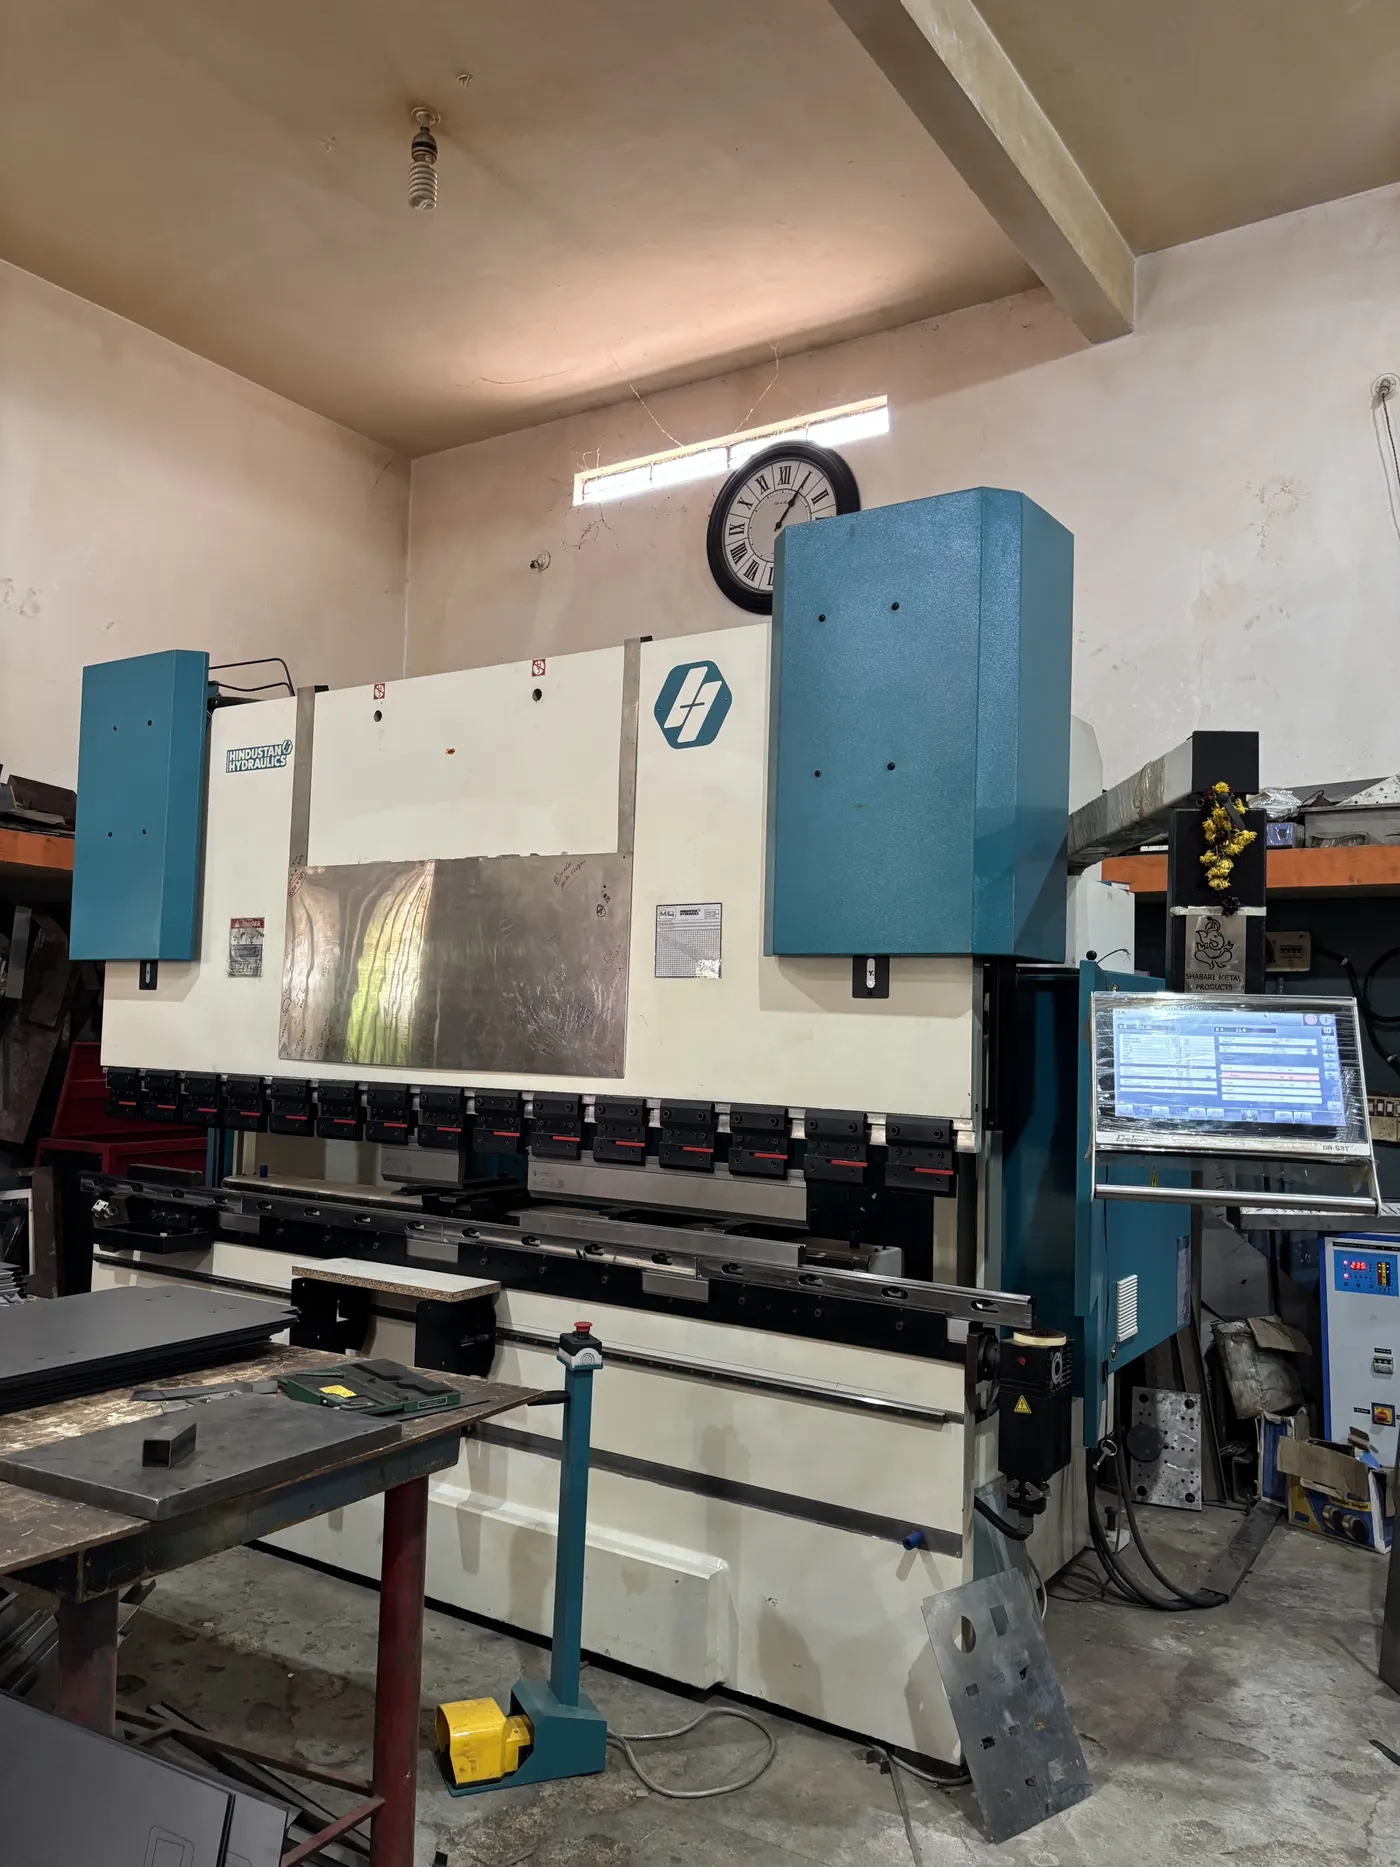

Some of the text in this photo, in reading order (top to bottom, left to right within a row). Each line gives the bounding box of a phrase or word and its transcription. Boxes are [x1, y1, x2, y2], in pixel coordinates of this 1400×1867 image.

[778, 465, 792, 486] XII
[755, 474, 771, 495] XI
[737, 496, 754, 511] X
[811, 488, 830, 505] II
[729, 522, 746, 537] IX
[730, 541, 748, 566] VIII
[743, 560, 760, 583] VII
[229, 746, 281, 761] HINDUSTAN
[229, 755, 286, 771] HYDRAULICS
[242, 920, 261, 928] DGER
[1185, 972, 1216, 981] SHABARI
[1195, 983, 1233, 991] PRODUCTS
[1350, 1261, 1367, 1270] 235
